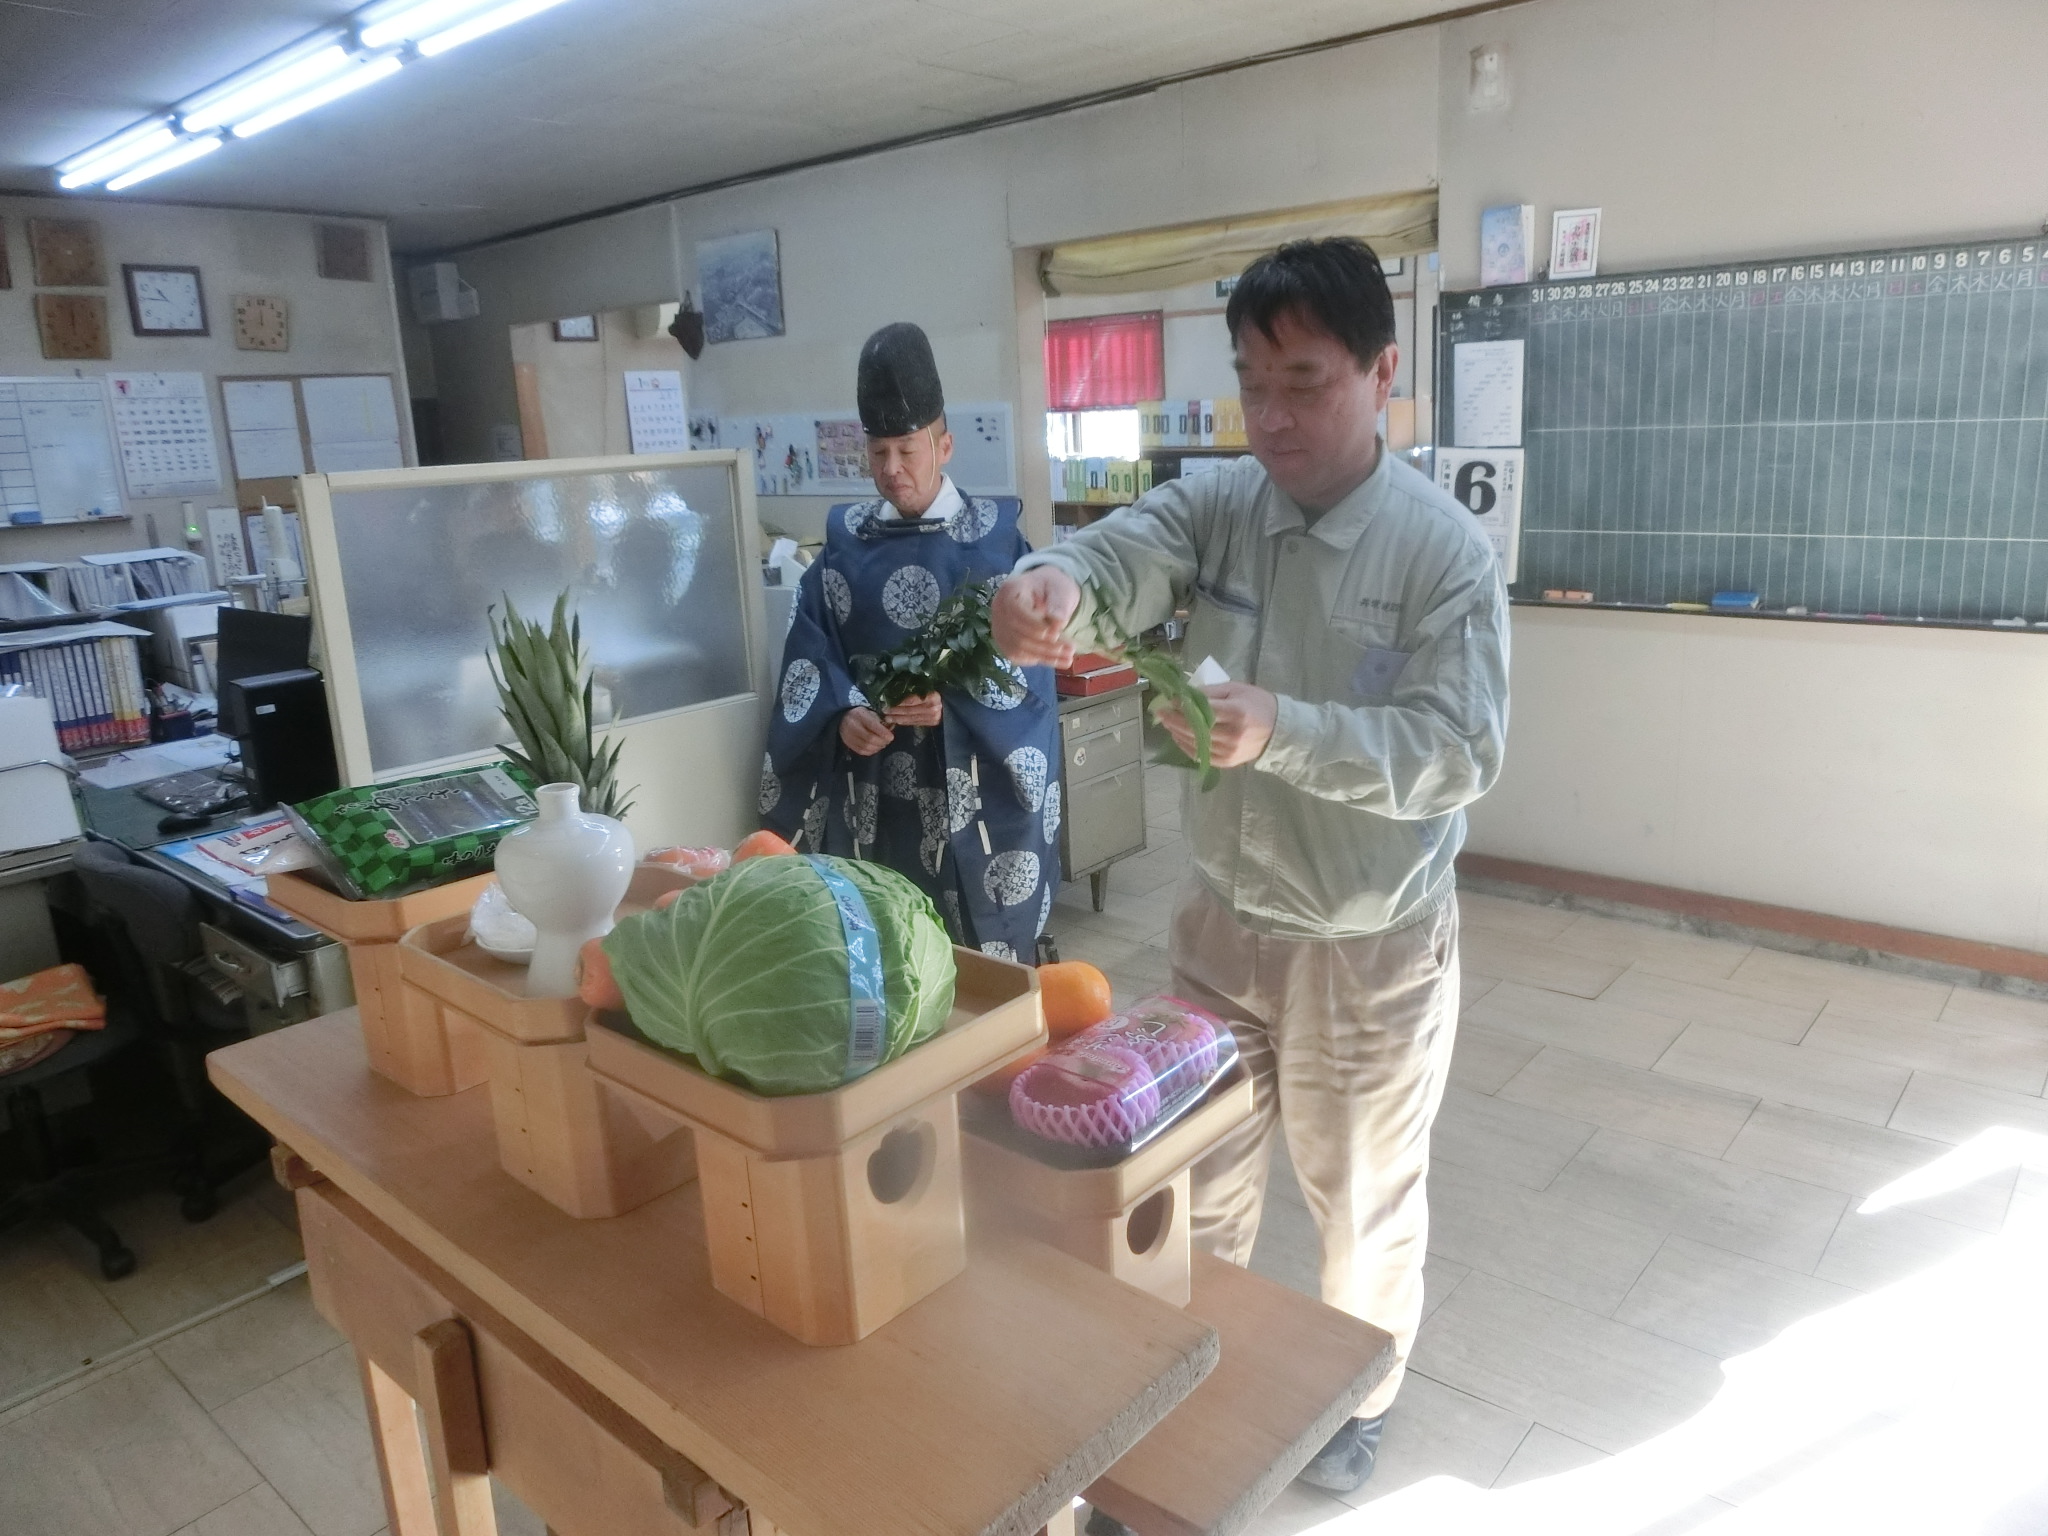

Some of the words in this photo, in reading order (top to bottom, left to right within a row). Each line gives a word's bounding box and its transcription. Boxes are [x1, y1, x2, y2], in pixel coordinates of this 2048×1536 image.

[1934, 253, 1946, 269] 9
[1955, 252, 1968, 267] 8
[1978, 250, 1990, 266] 7
[1999, 249, 2011, 264] 6
[2022, 246, 2034, 262] 5
[1830, 262, 1844, 278] 14
[1850, 261, 1864, 276] 13
[1870, 259, 1885, 274] 12
[1891, 259, 1905, 273] 11
[1911, 255, 1926, 271] 10
[1716, 272, 1731, 286] 20
[1735, 271, 1748, 286] 19
[1753, 269, 1767, 284] 18
[1772, 267, 1787, 283] 17
[1791, 265, 1804, 280] 16
[1810, 264, 1824, 279] 15
[2016, 268, 2033, 287] 月
[1628, 280, 1643, 294] 25
[1645, 279, 1659, 293] 24
[1662, 277, 1677, 291] 23
[1679, 276, 1694, 290] 22
[1697, 274, 1711, 288] 21
[1928, 275, 1947, 293] 金
[1949, 274, 1968, 294] 木
[1969, 271, 1990, 293] 水
[1994, 271, 2013, 290] 火
[1532, 288, 1544, 303] 31
[1547, 287, 1561, 301] 30
[1562, 285, 1576, 300] 29
[1579, 284, 1592, 298] 28
[1595, 283, 1610, 297] 27
[1611, 282, 1625, 296] 26
[1785, 285, 1806, 301] 金
[1845, 281, 1863, 299] 火
[1866, 281, 1880, 299] 月
[1661, 295, 1677, 312] 金
[1731, 290, 1745, 309] 月
[1454, 461, 1496, 515] 6
